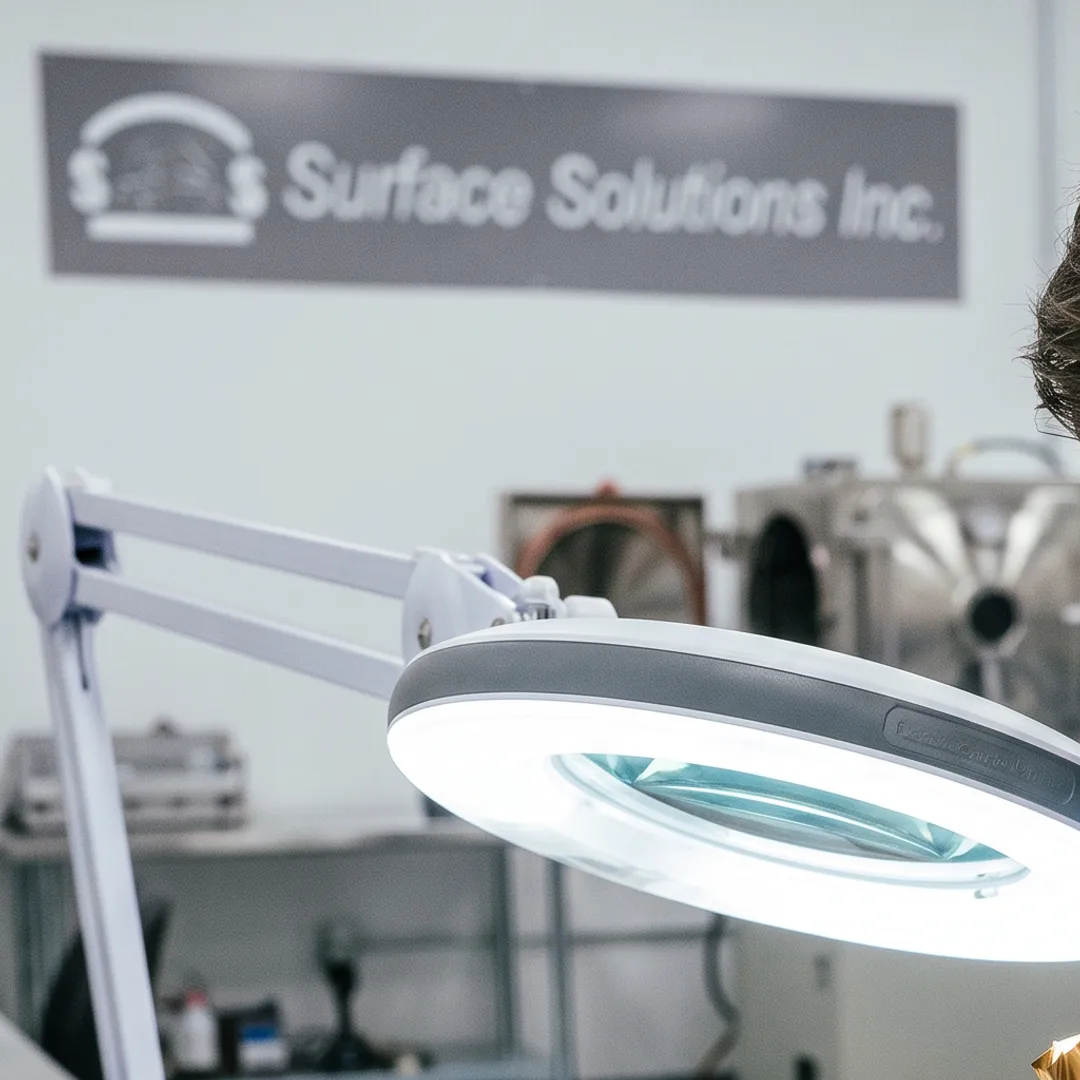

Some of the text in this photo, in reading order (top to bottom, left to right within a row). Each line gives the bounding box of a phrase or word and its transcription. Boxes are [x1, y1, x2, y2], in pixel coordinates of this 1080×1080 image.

[284, 141, 944, 242] Surface Solutions Inc.
